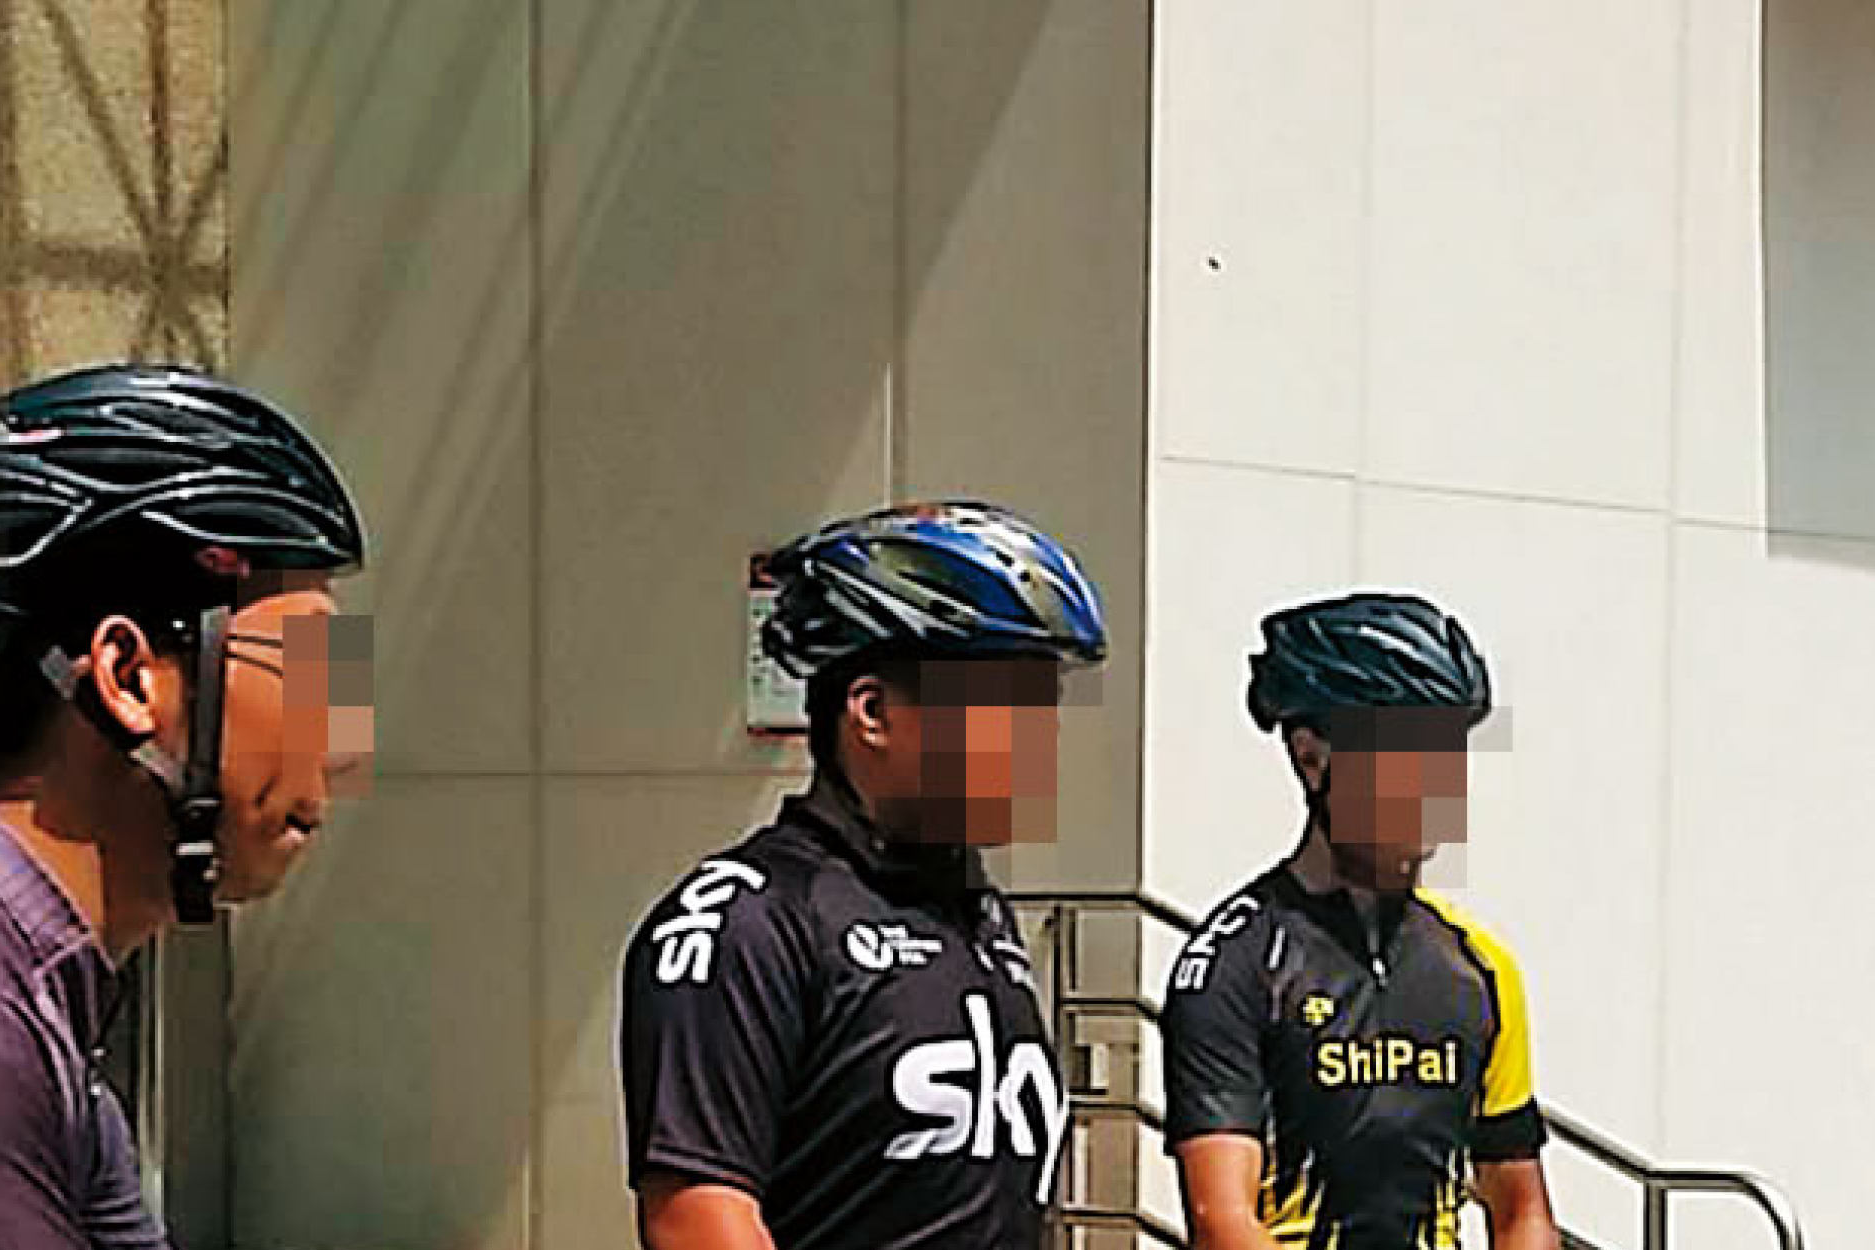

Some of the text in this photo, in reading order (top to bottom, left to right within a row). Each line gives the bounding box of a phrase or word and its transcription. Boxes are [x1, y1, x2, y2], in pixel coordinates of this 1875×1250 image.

[652, 859, 767, 983] sky
[882, 993, 1068, 1204] sky
[1316, 1039, 1458, 1085] ShiPai
